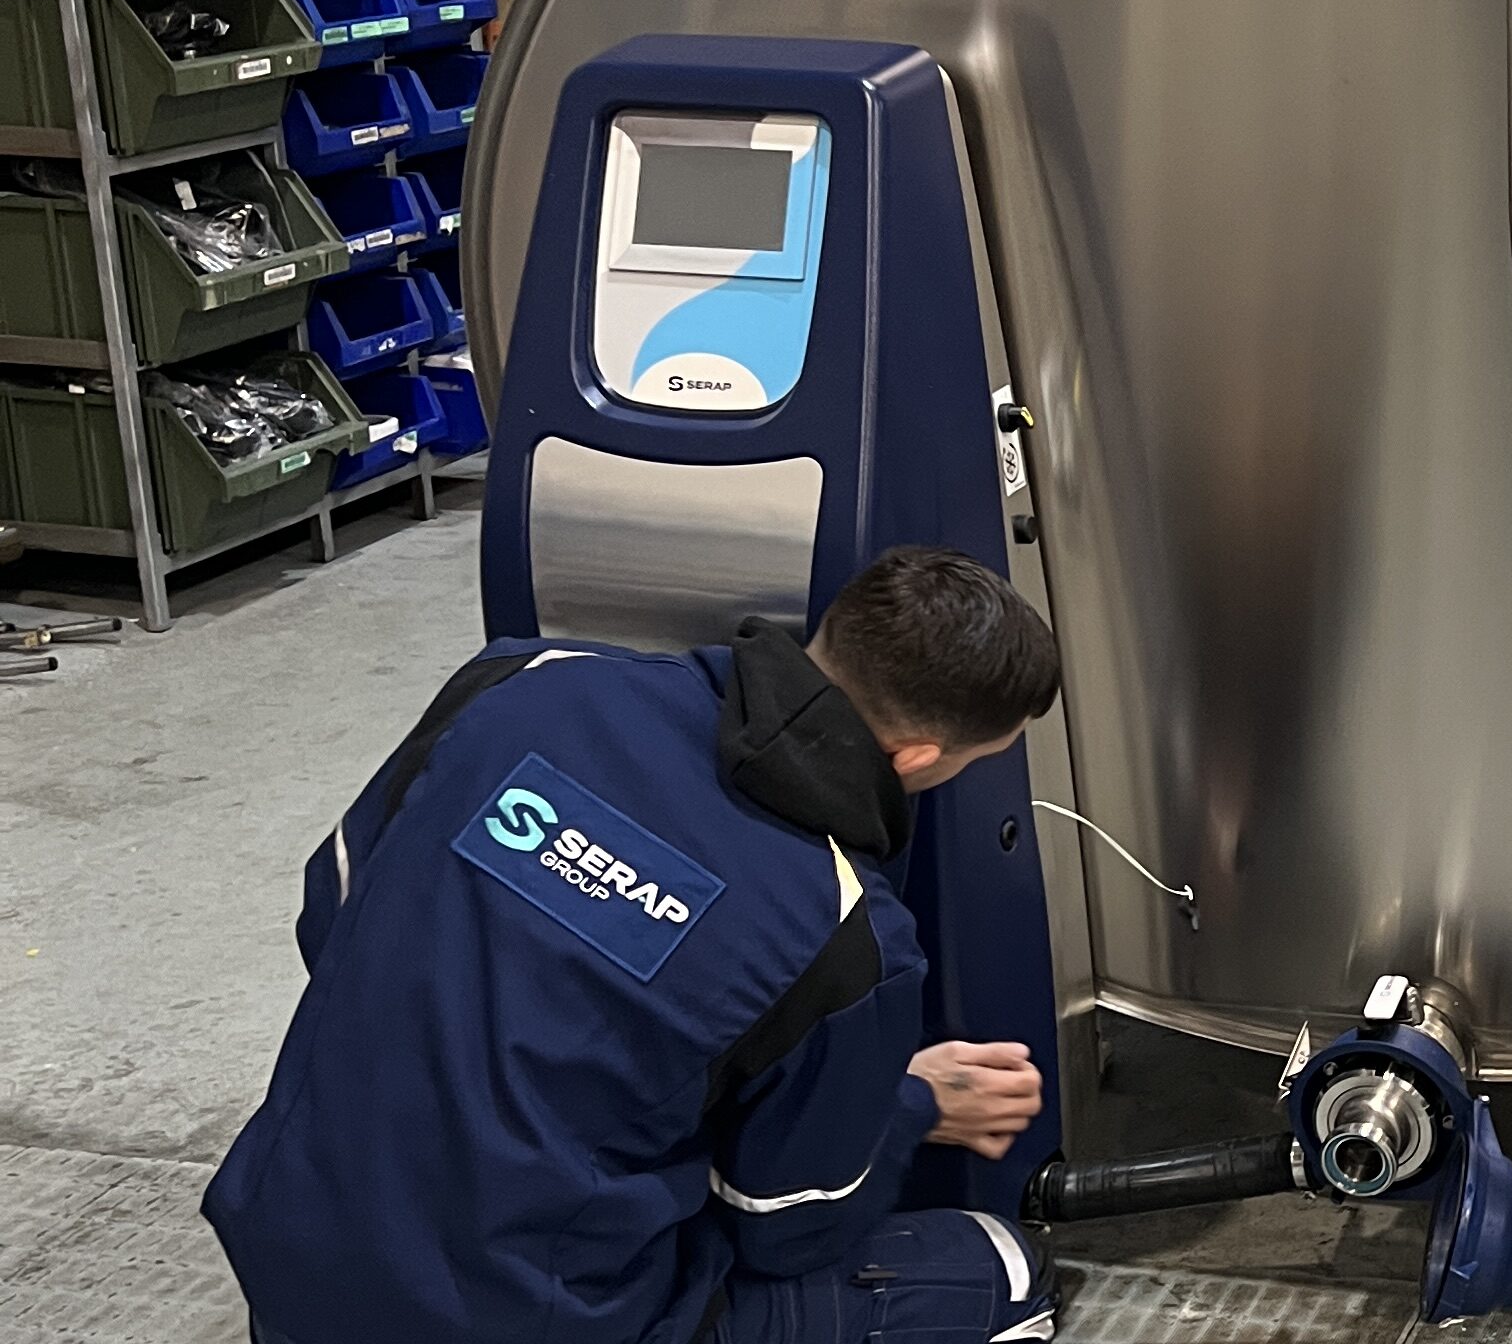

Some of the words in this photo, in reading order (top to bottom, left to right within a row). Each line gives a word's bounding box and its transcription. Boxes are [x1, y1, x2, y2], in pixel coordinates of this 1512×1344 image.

[686, 380, 732, 391] SERAP
[539, 851, 610, 900] GROUP
[553, 828, 690, 924] SERAP
